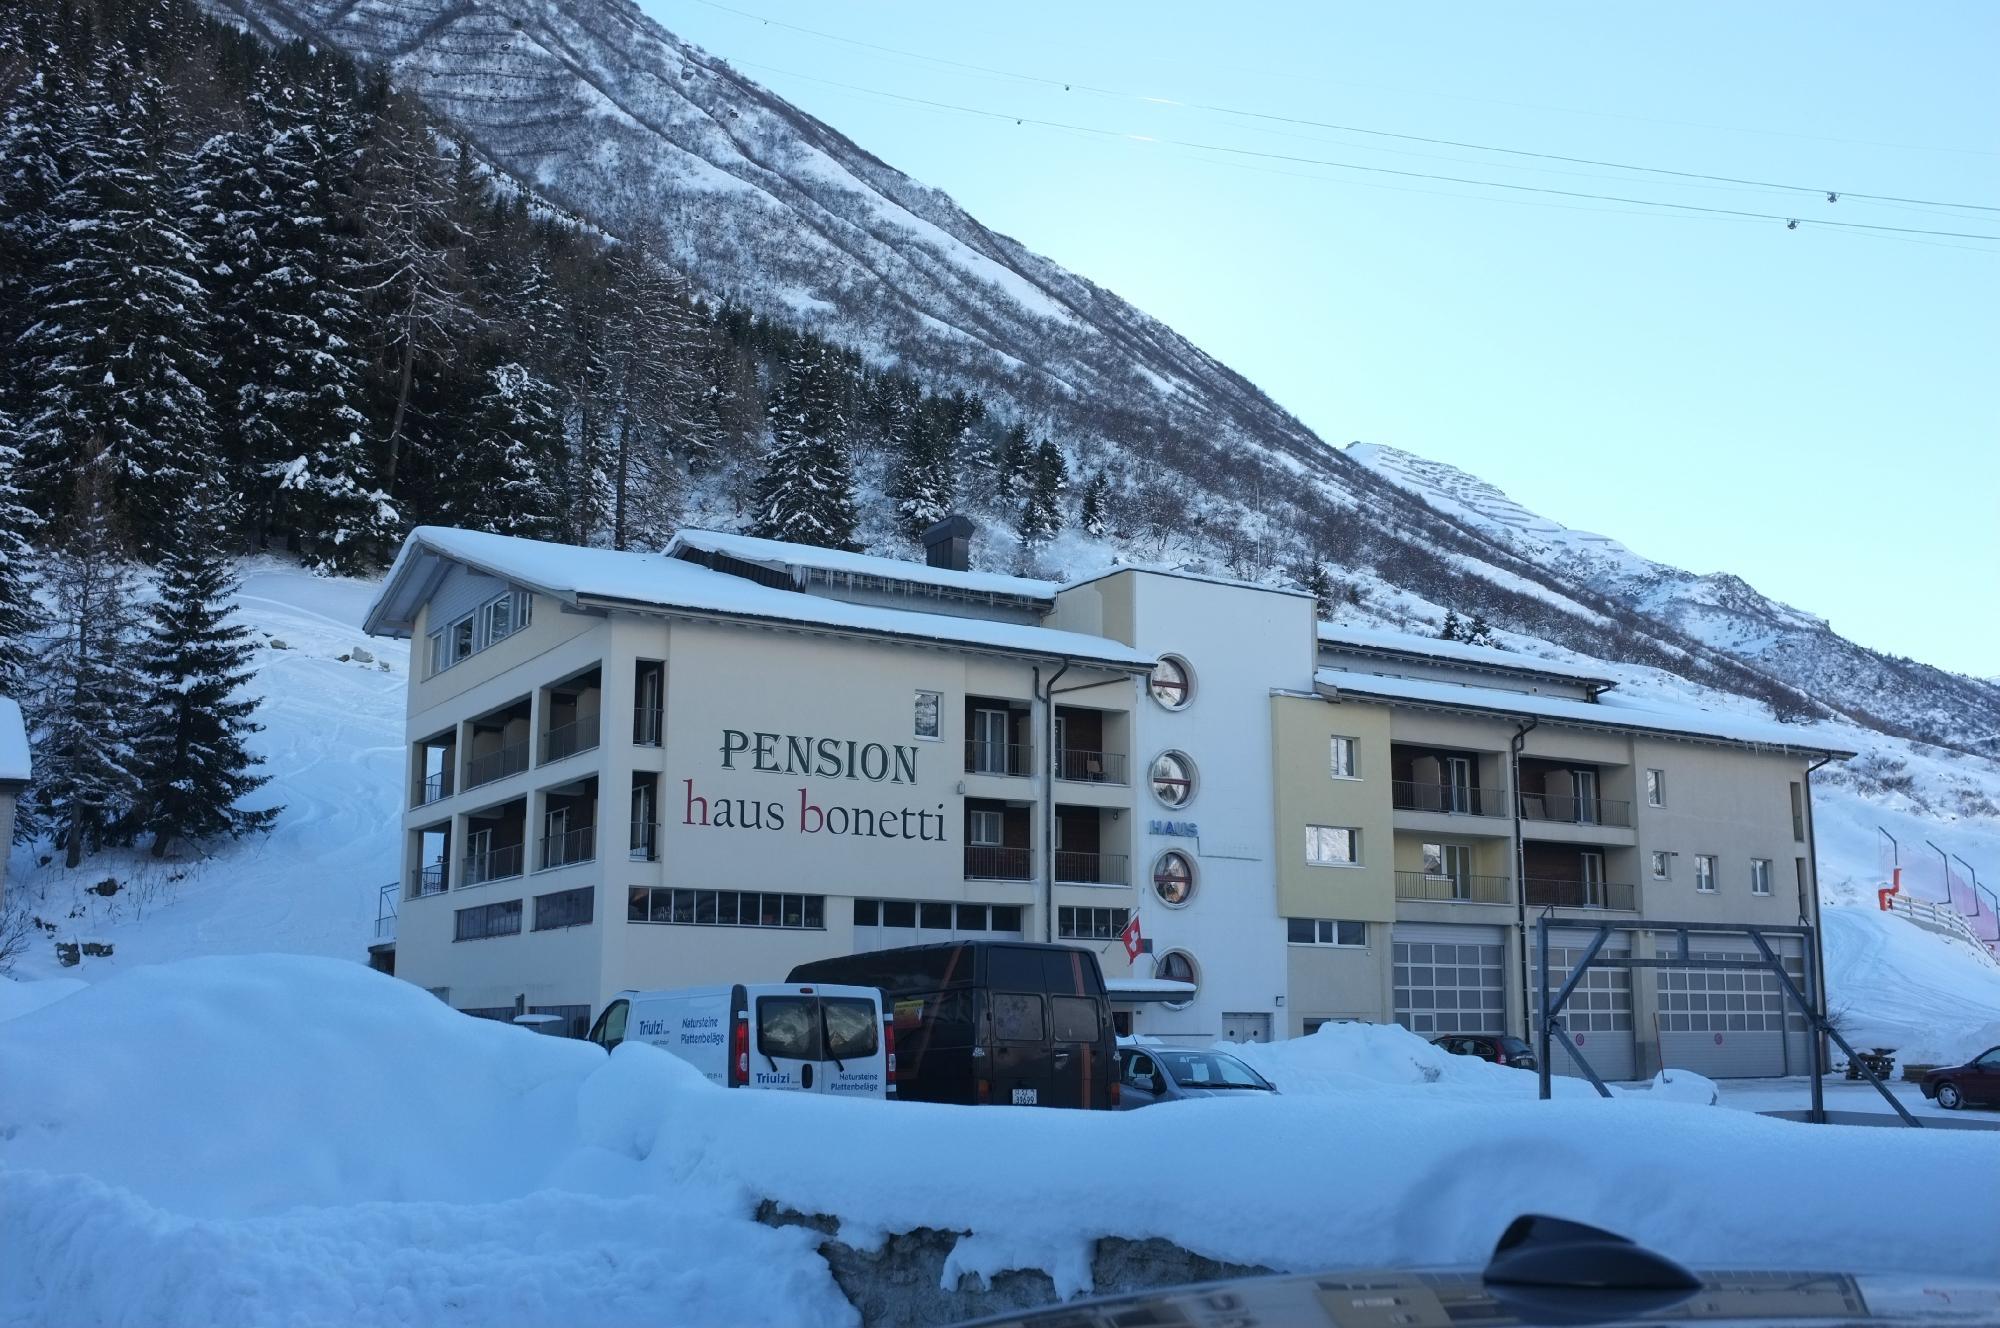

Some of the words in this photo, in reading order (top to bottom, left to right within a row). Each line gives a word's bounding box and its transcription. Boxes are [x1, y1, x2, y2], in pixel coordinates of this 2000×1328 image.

[719, 729, 920, 785] PENSION
[682, 778, 785, 831] haus
[798, 788, 948, 842] bonetti
[1150, 820, 1198, 837] HAUS
[639, 1019, 664, 1036] Triulzi
[682, 1017, 718, 1029] Natursteine
[680, 1032, 724, 1046] Plattenbeläge
[756, 1072, 790, 1084] Triulzi
[839, 1073, 878, 1081] Natursteine
[830, 1082, 878, 1092] Plattenbeläge
